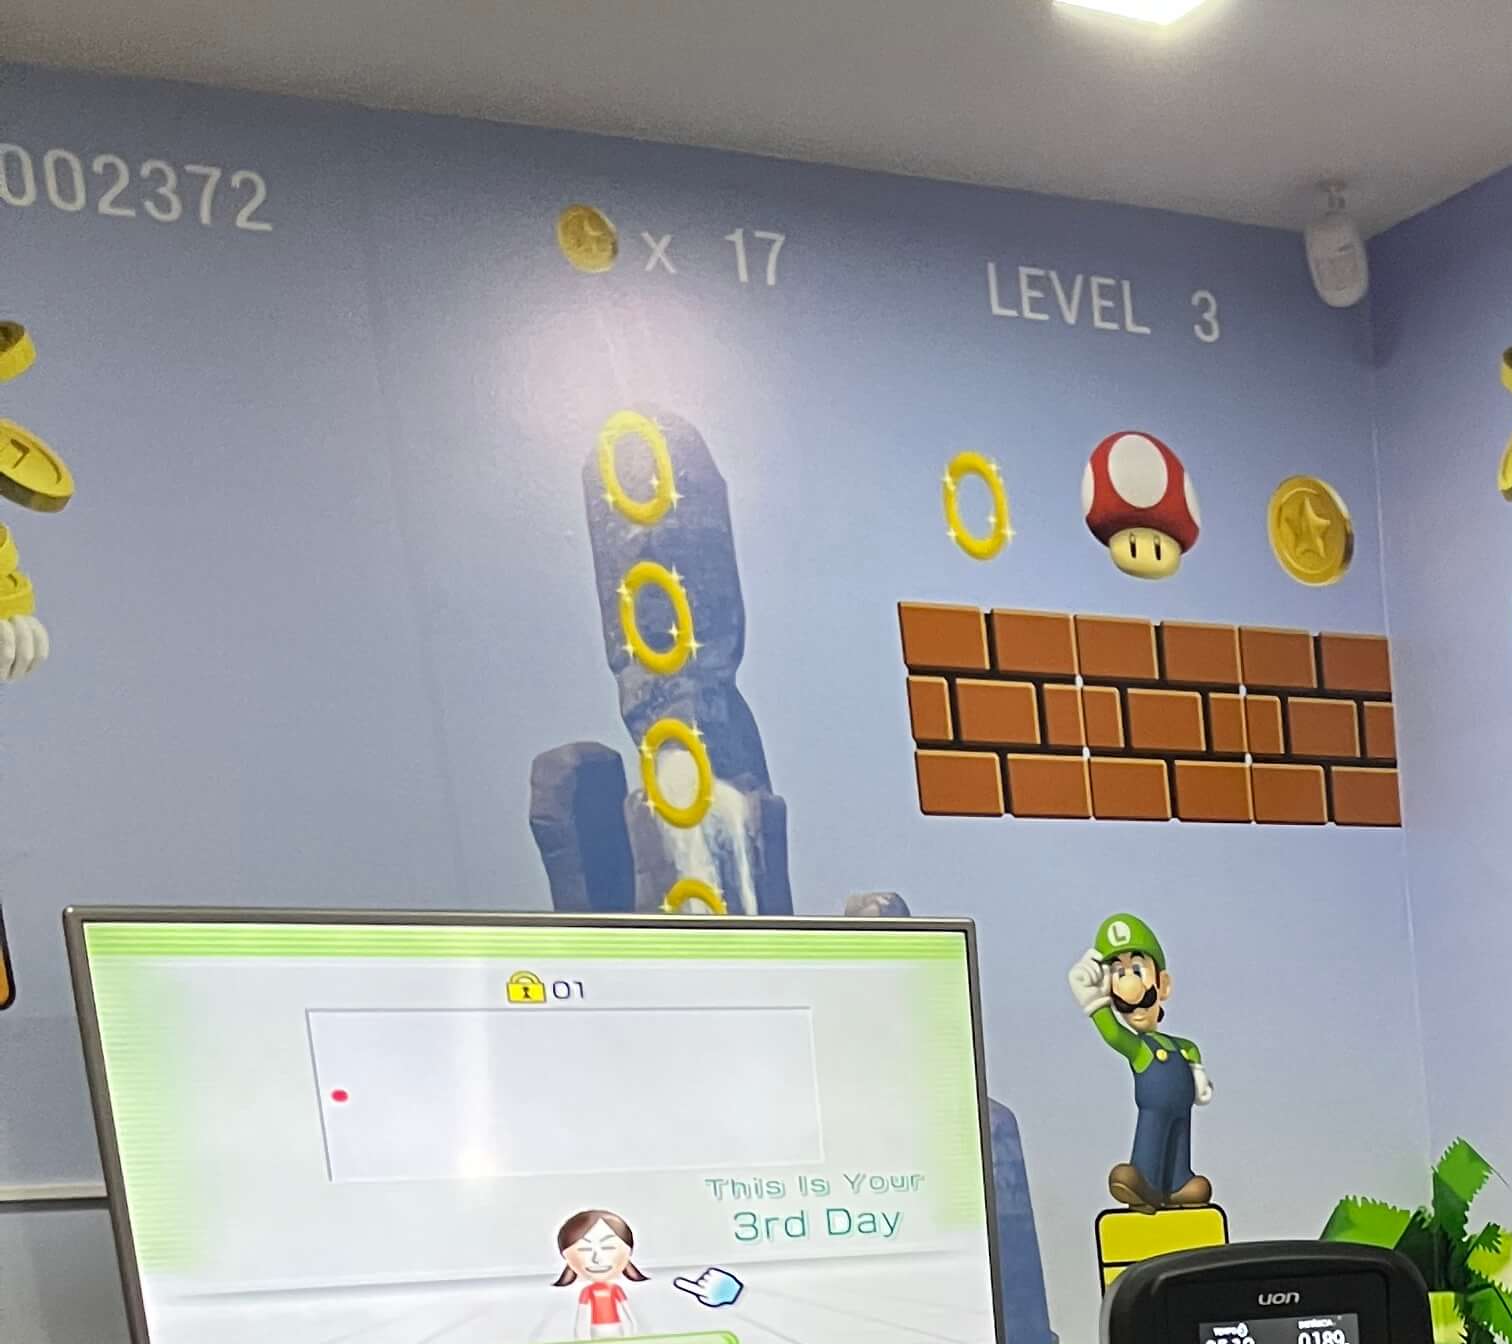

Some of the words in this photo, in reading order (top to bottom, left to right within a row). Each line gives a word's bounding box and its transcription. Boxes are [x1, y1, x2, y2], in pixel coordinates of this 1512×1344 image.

[0, 143, 272, 231] 002372
[725, 228, 786, 286] 17
[987, 262, 1151, 334] LEVEL
[1191, 289, 1220, 343] 3
[552, 980, 584, 999] 01
[704, 1177, 785, 1200] This
[798, 1175, 830, 1197] Is
[843, 1173, 926, 1193] Your
[734, 1210, 807, 1242] 3rd
[826, 1207, 901, 1238] Day
